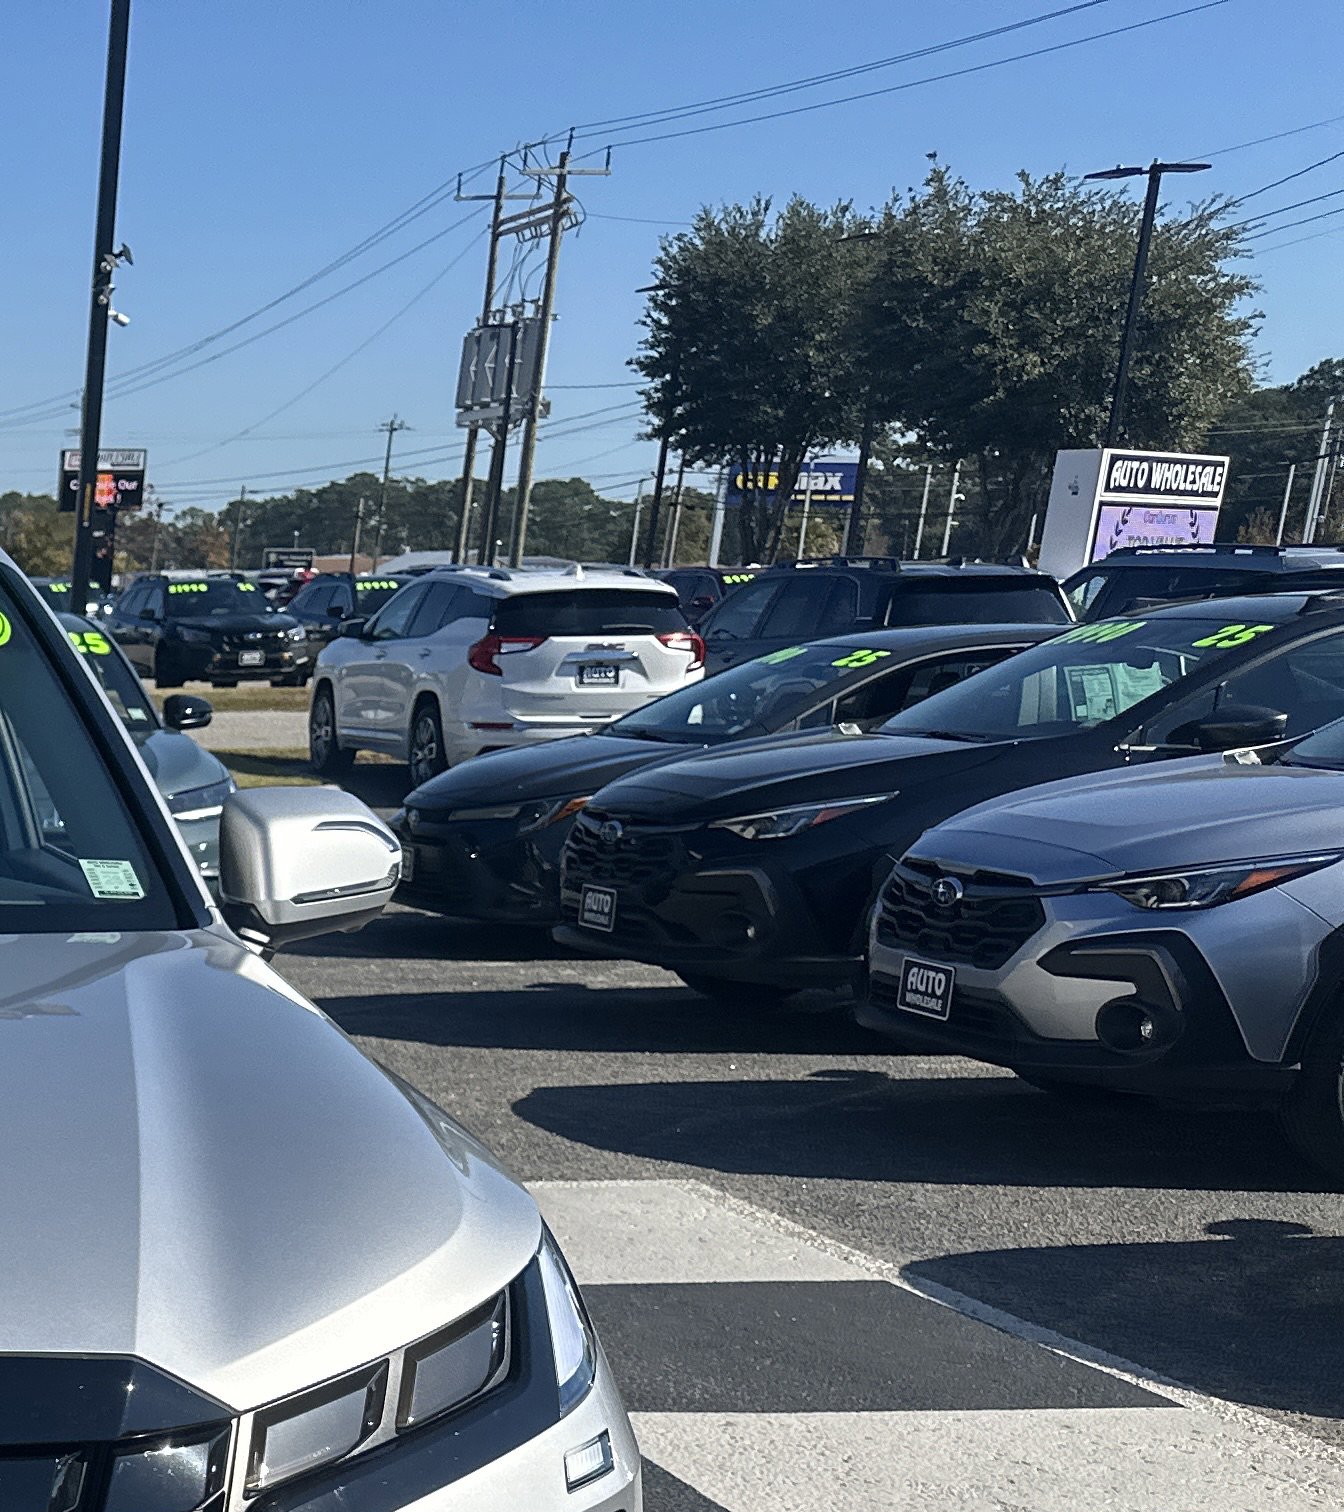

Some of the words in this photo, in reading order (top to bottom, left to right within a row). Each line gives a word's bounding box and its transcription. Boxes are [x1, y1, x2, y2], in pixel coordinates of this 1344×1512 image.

[1109, 460, 1149, 489] AUTO
[1150, 462, 1224, 494] WHOLESALE
[67, 631, 111, 656] 25
[1191, 624, 1275, 649] 25
[831, 649, 892, 668] 25
[584, 891, 612, 913] AUTO
[907, 967, 946, 996] AUTO
